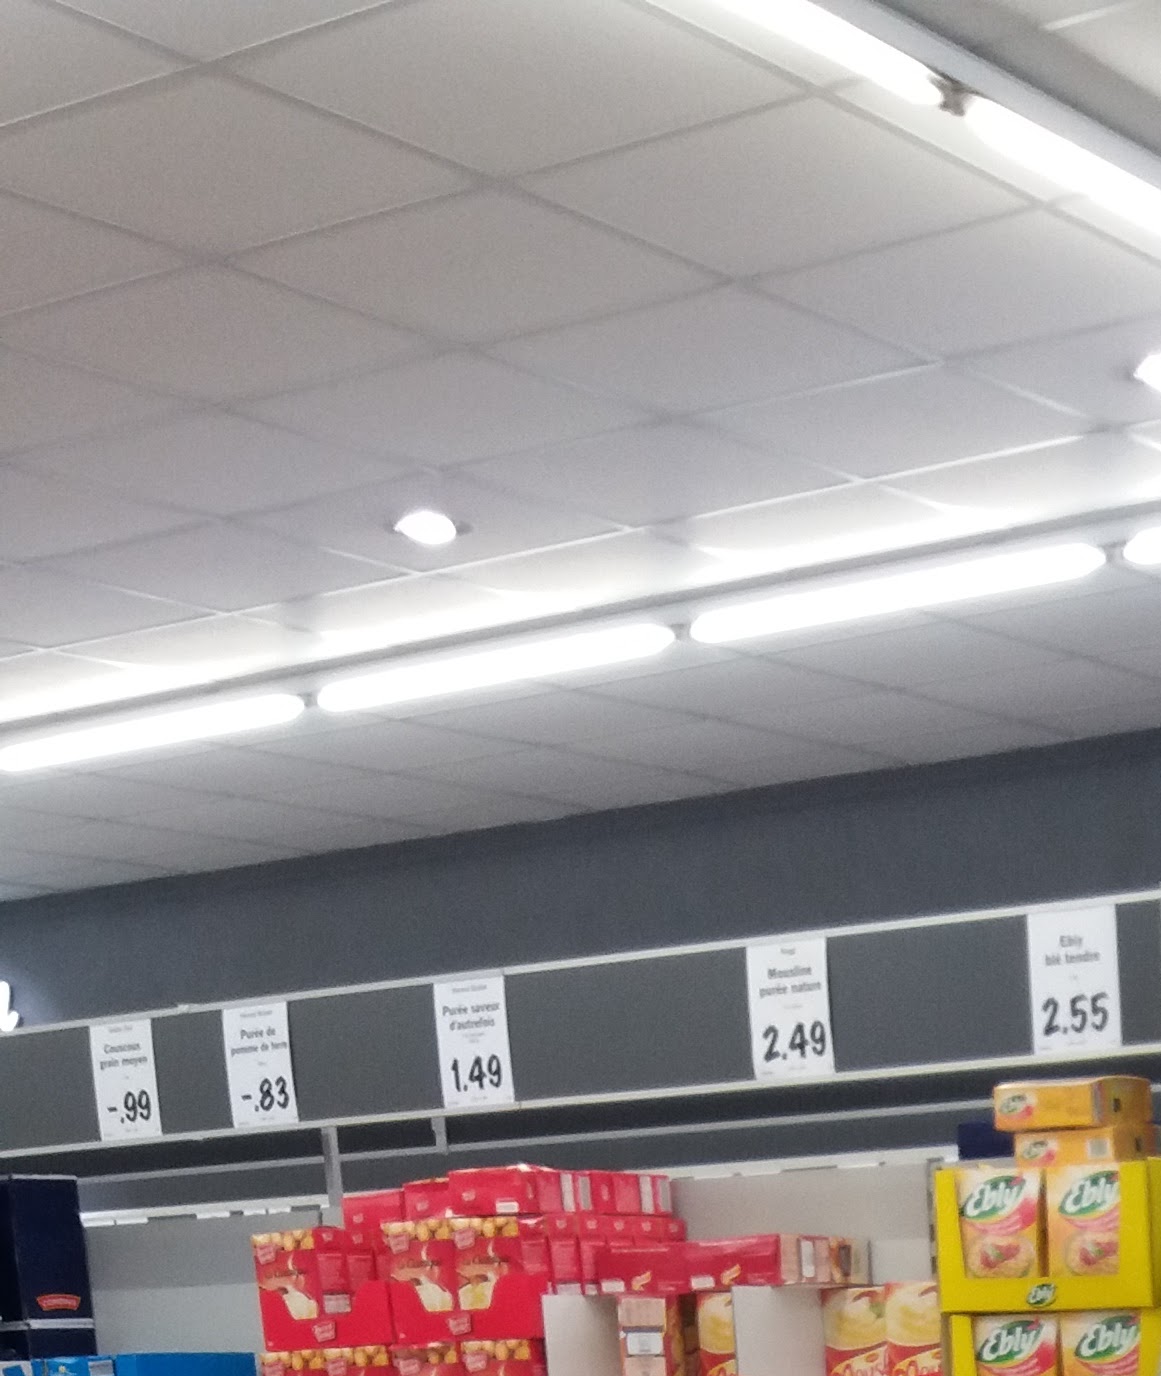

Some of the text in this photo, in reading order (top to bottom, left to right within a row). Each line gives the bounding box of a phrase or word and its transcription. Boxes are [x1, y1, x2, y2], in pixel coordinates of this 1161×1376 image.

[1059, 934, 1084, 948] Ebly
[767, 965, 812, 979] Mousline
[790, 981, 822, 993] nature
[442, 1005, 468, 1016] Purée
[1042, 991, 1109, 1037] 2.55
[103, 1043, 140, 1054] Couscous
[240, 1027, 265, 1040] Purée
[762, 1020, 827, 1063] 2.49
[450, 1054, 502, 1092] 1.49
[107, 1089, 151, 1124] -.99
[241, 1076, 290, 1112] -.83
[964, 1178, 1026, 1216] Ebly
[1062, 1176, 1119, 1216] Ebly
[981, 1322, 1042, 1360] Ebly
[1080, 1320, 1140, 1358] Ebly
